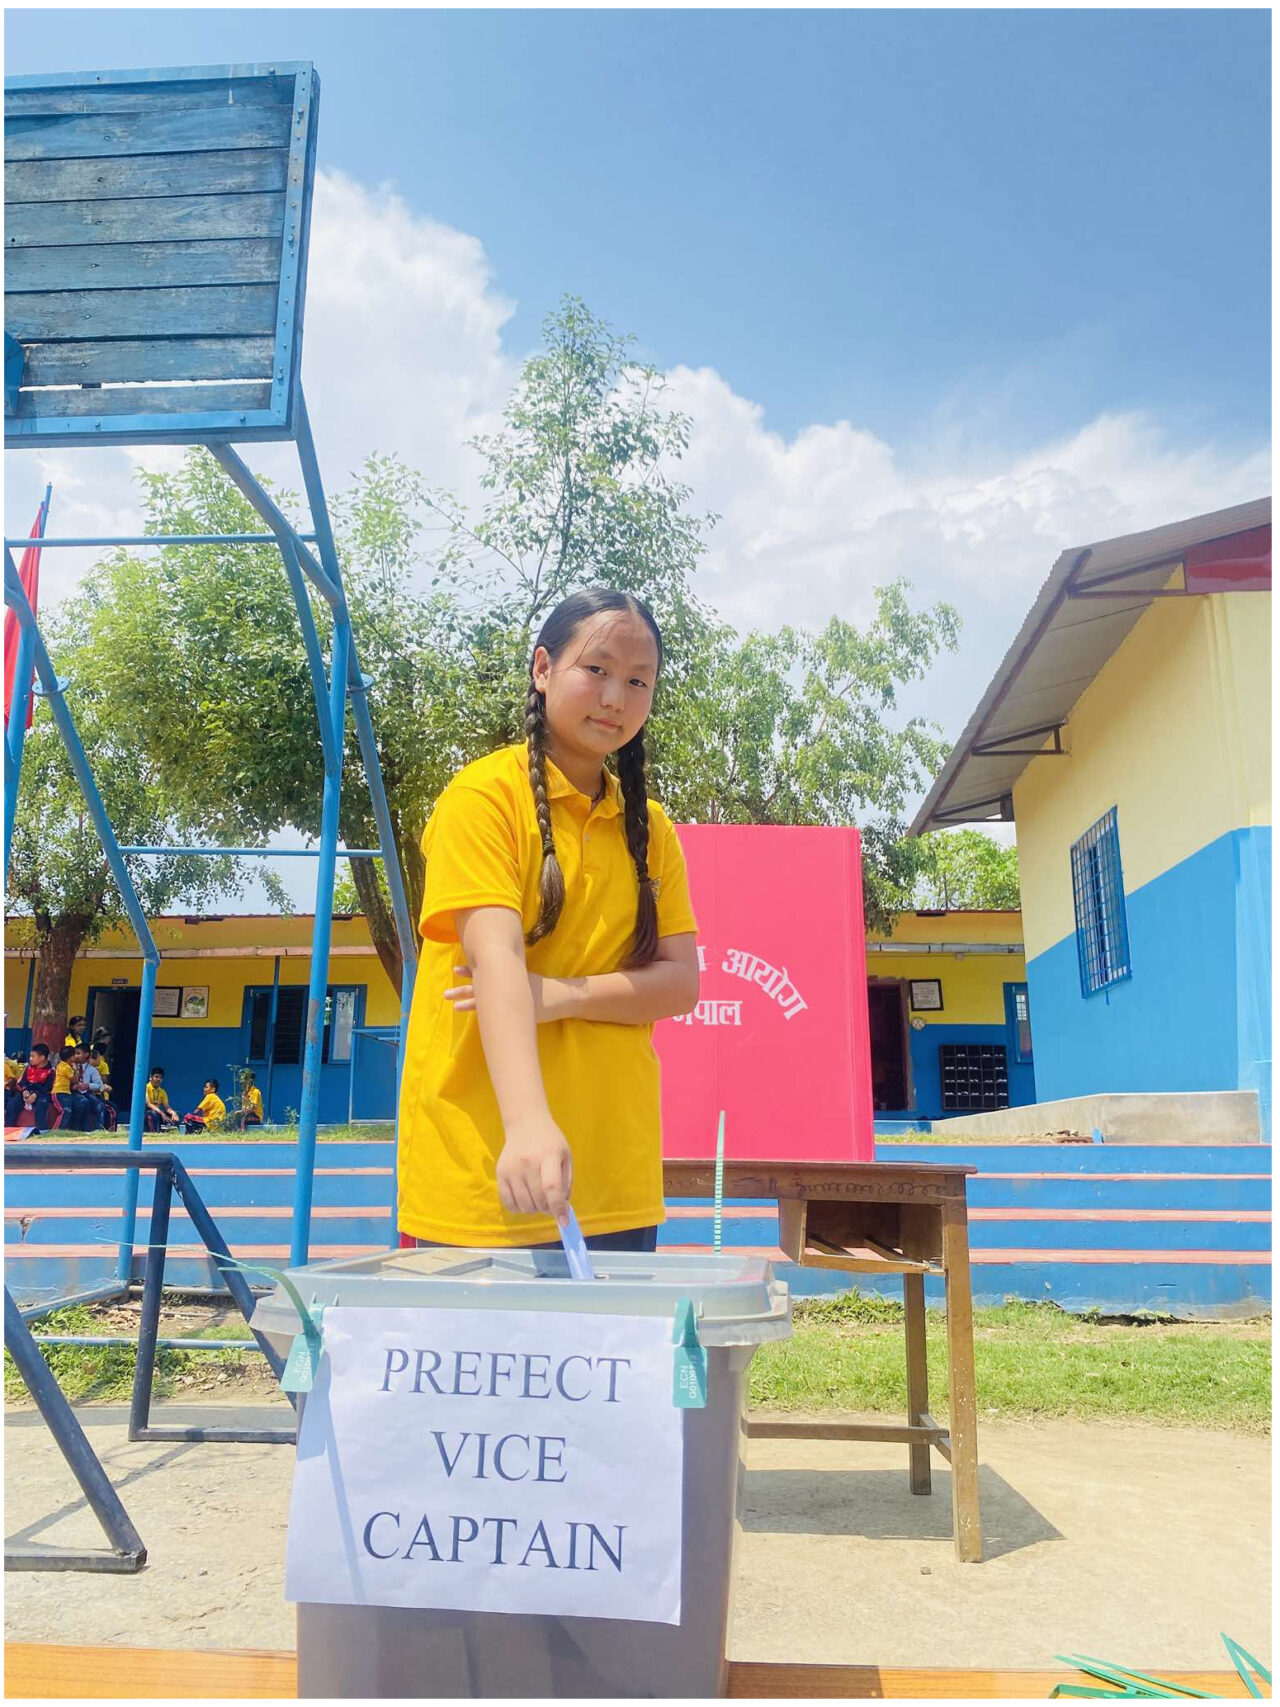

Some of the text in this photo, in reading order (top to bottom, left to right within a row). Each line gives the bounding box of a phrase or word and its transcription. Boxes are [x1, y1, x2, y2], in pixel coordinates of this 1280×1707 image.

[721, 948, 808, 1021] आयोग
[378, 1348, 632, 1404] PREFECT
[679, 1365, 689, 1389] ECN
[430, 1430, 569, 1483] VICE
[362, 1511, 630, 1573] CAPTAIN
